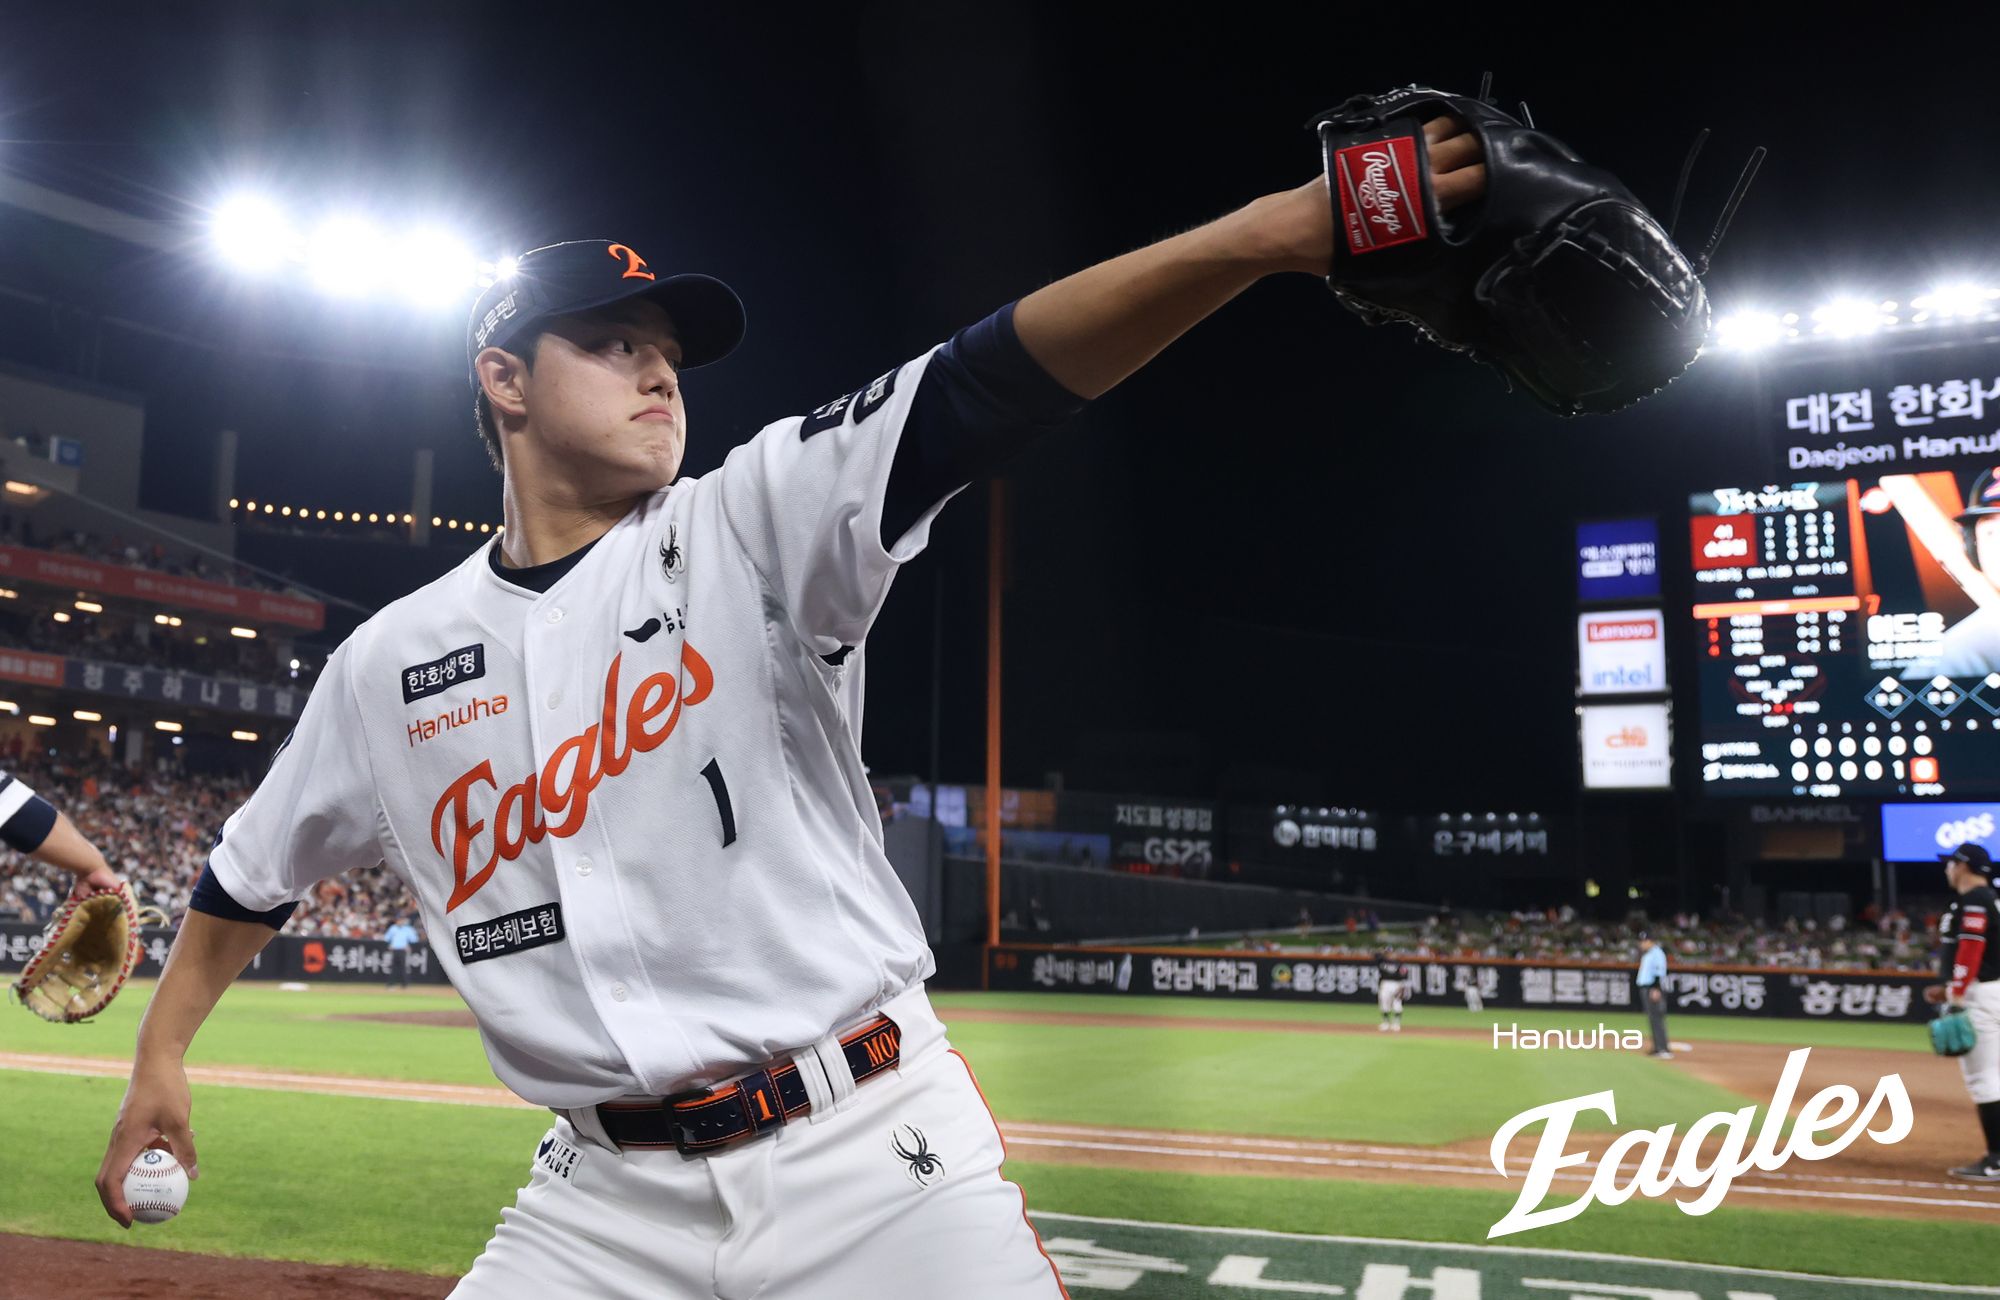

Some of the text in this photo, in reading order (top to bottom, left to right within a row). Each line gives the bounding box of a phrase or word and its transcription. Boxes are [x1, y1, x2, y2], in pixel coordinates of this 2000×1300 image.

[1358, 151, 1402, 234] Rawlings
[474, 290, 518, 349] 부루펜
[1787, 388, 1874, 434] 대전
[1789, 442, 1896, 470] Daejeon
[1590, 621, 1654, 641] Lenovo
[407, 651, 475, 693] 한화생명
[1592, 664, 1652, 685] intel
[407, 694, 509, 747] Hanwha
[431, 639, 713, 914] Eagles
[700, 757, 737, 848] 1
[1144, 837, 1212, 867] GS25
[458, 910, 558, 957] 한화손해보험
[327, 944, 428, 974] 육회바른어
[1151, 957, 1258, 991] 한남대학교
[752, 1089, 775, 1121] 1
[545, 1155, 569, 1178] PLUS
[552, 1142, 577, 1164] LIFE
